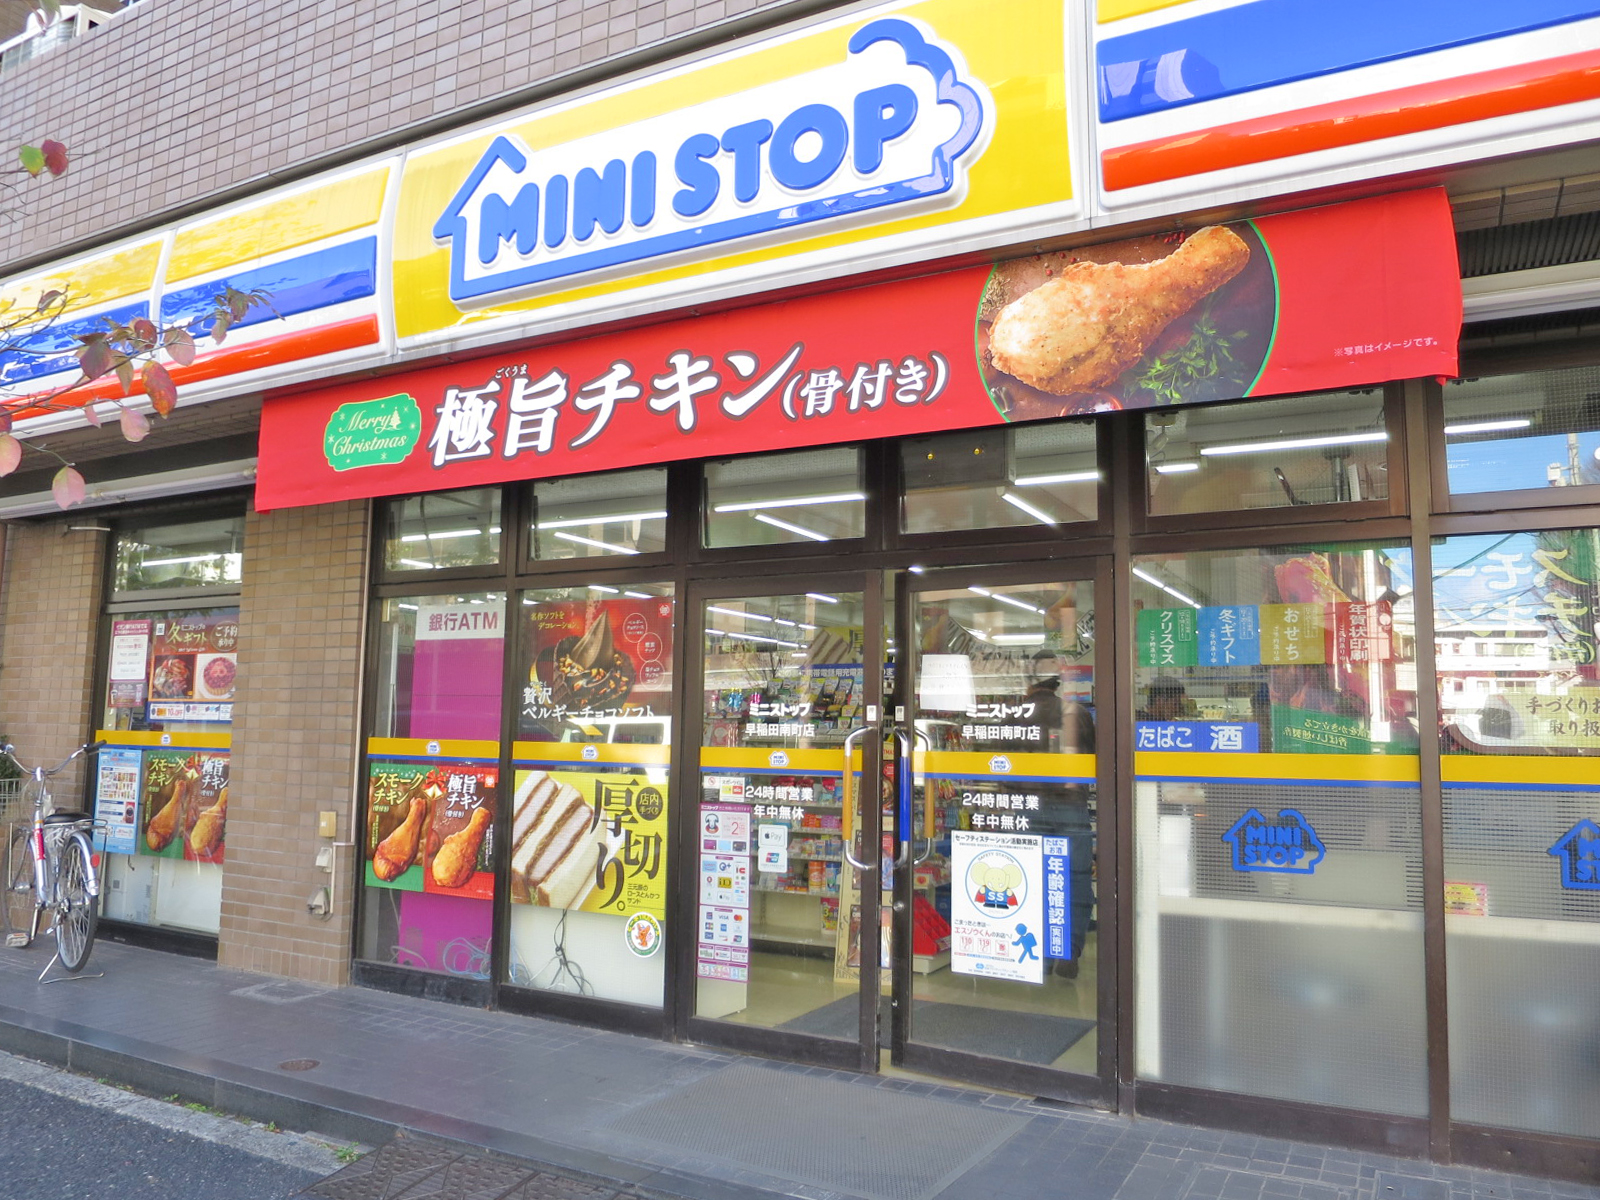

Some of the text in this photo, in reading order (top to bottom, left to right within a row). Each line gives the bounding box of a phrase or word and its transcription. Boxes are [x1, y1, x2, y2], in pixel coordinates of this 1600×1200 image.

[478, 83, 919, 265] MINI STOP
[1333, 336, 1438, 357] ※写真はイメージです。
[494, 363, 528, 379] ごくうま
[338, 409, 396, 435] Merry
[332, 435, 407, 457] Christmas
[428, 611, 499, 632] 銀行ATM
[1159, 610, 1175, 665] クリスマス
[1218, 609, 1237, 664] 冬ギフト
[1283, 608, 1300, 661] おせち
[1348, 603, 1369, 662] 年賀状印刷
[522, 687, 553, 705] 贅沢
[522, 704, 655, 722] ベルギーチョコソフト
[749, 702, 811, 718] ミニストップ
[965, 702, 1036, 718] ミニストップ
[744, 723, 816, 738] 早稲田南町店
[962, 725, 1041, 741] 早稲田南町店
[1138, 725, 1193, 748] たばこ
[1210, 725, 1244, 750] 酒
[1549, 719, 1600, 738] 取り扱
[147, 772, 174, 787] チキン
[202, 776, 229, 790] チキン
[374, 772, 424, 790] スモーク
[447, 773, 478, 794] 極旨
[373, 788, 409, 805] チキン
[446, 793, 485, 810] チキン
[639, 792, 660, 806] 店内
[745, 786, 814, 802] 24時間営業
[962, 793, 1040, 810] 24時間営業
[753, 804, 805, 820] 年中無休
[971, 813, 1030, 830] 年中無休
[1246, 825, 1301, 845] MINI
[1244, 844, 1305, 866] STOP
[1576, 859, 1600, 881] ST
[987, 891, 1005, 902] SS
[1047, 857, 1065, 925] 年齢確認
[961, 936, 973, 945] 110
[979, 937, 990, 947] 119
[1052, 927, 1062, 956] 実施中
